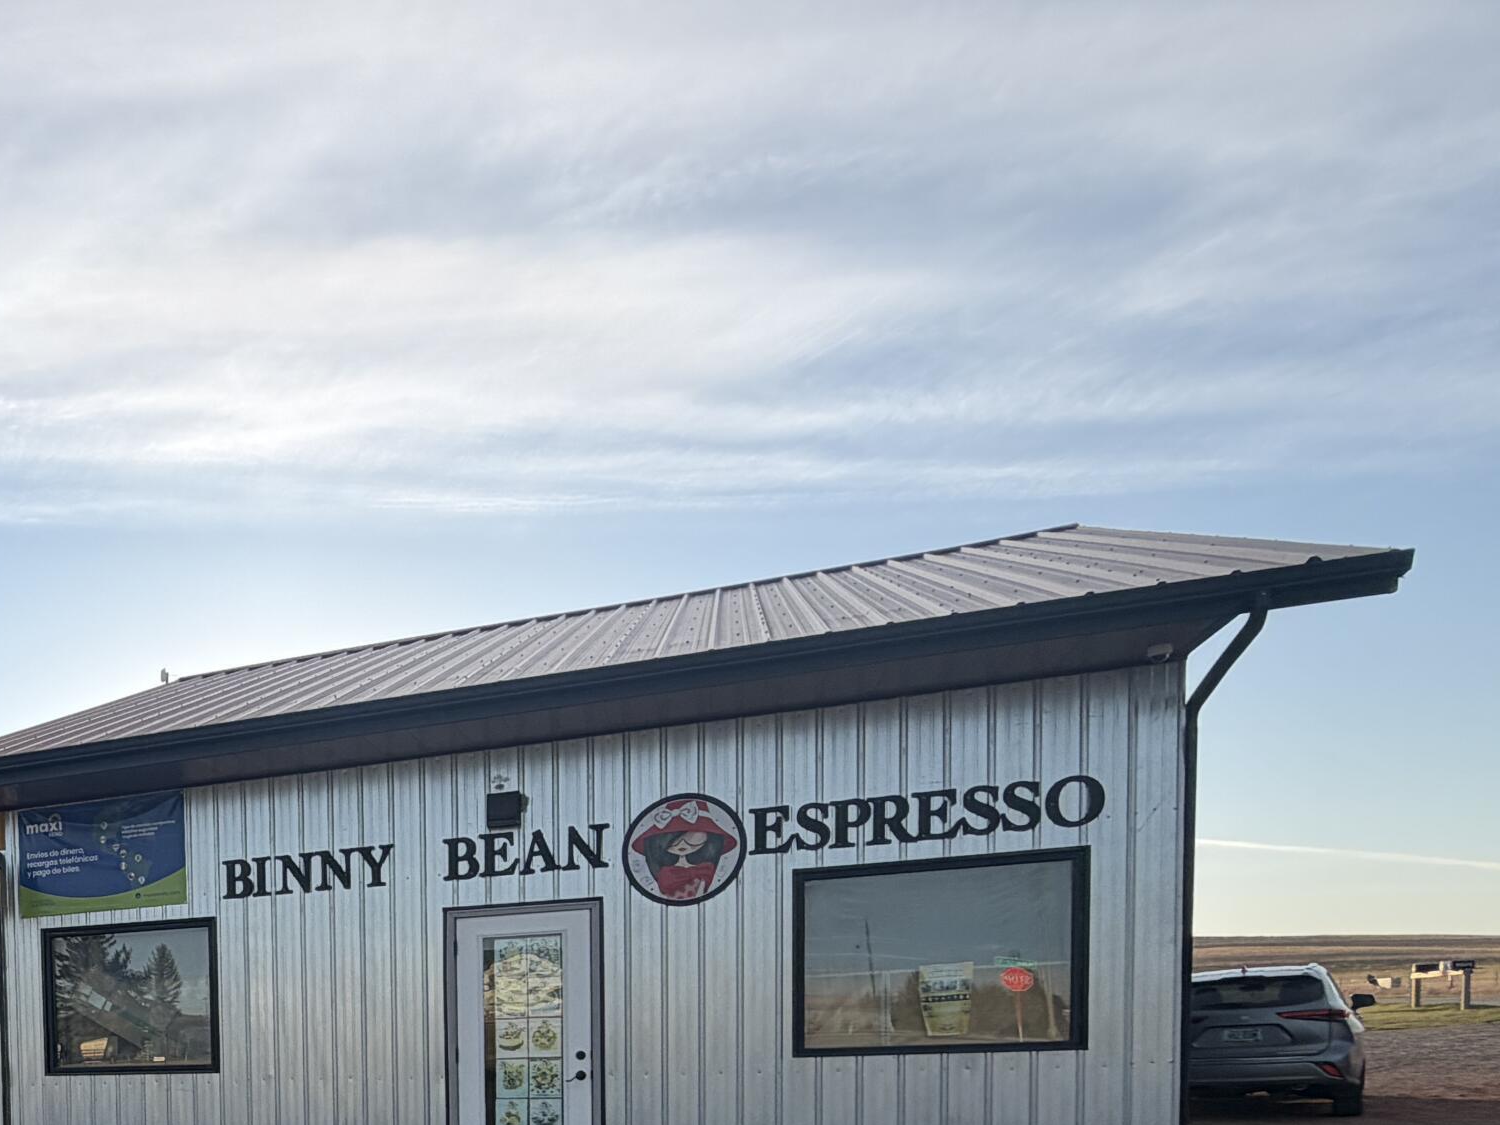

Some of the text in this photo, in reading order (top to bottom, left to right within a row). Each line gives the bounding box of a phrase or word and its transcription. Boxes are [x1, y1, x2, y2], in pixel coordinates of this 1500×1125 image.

[26, 821, 63, 835] maxi
[222, 843, 395, 900] BINNY
[443, 823, 610, 881] BEAN
[748, 775, 1106, 855] ESPRESSO
[49, 849, 59, 857] de
[32, 868, 51, 878] pago
